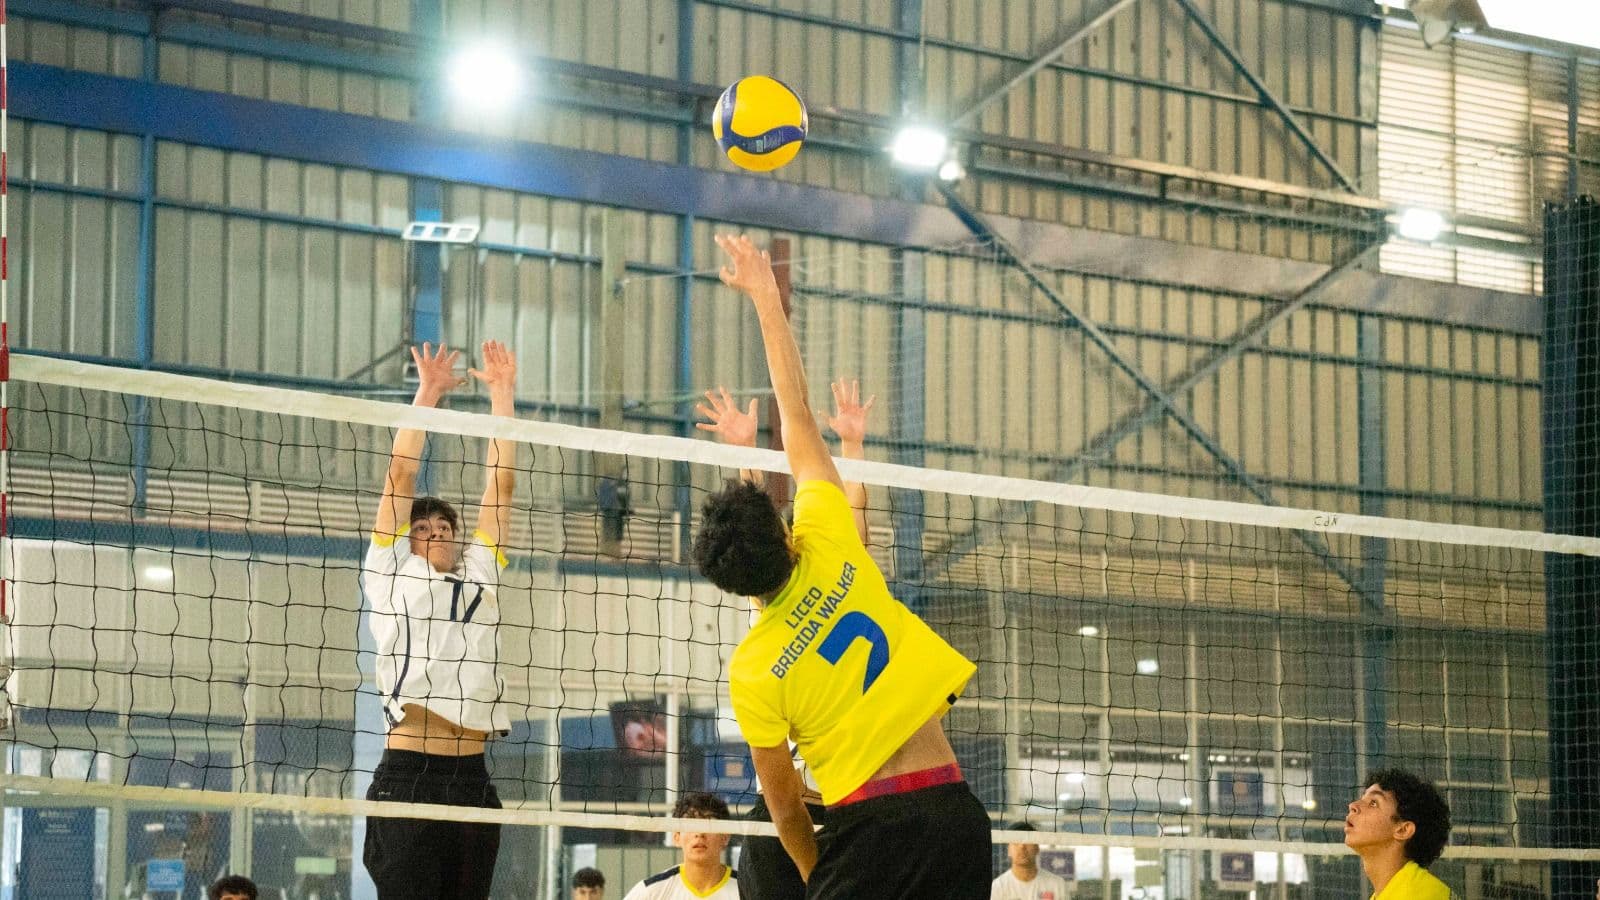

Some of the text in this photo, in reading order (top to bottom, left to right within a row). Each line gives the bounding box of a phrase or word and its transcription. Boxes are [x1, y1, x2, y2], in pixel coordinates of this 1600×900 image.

[771, 561, 857, 679] BRÍGIDA WALKER
[785, 586, 823, 629] LICEO
